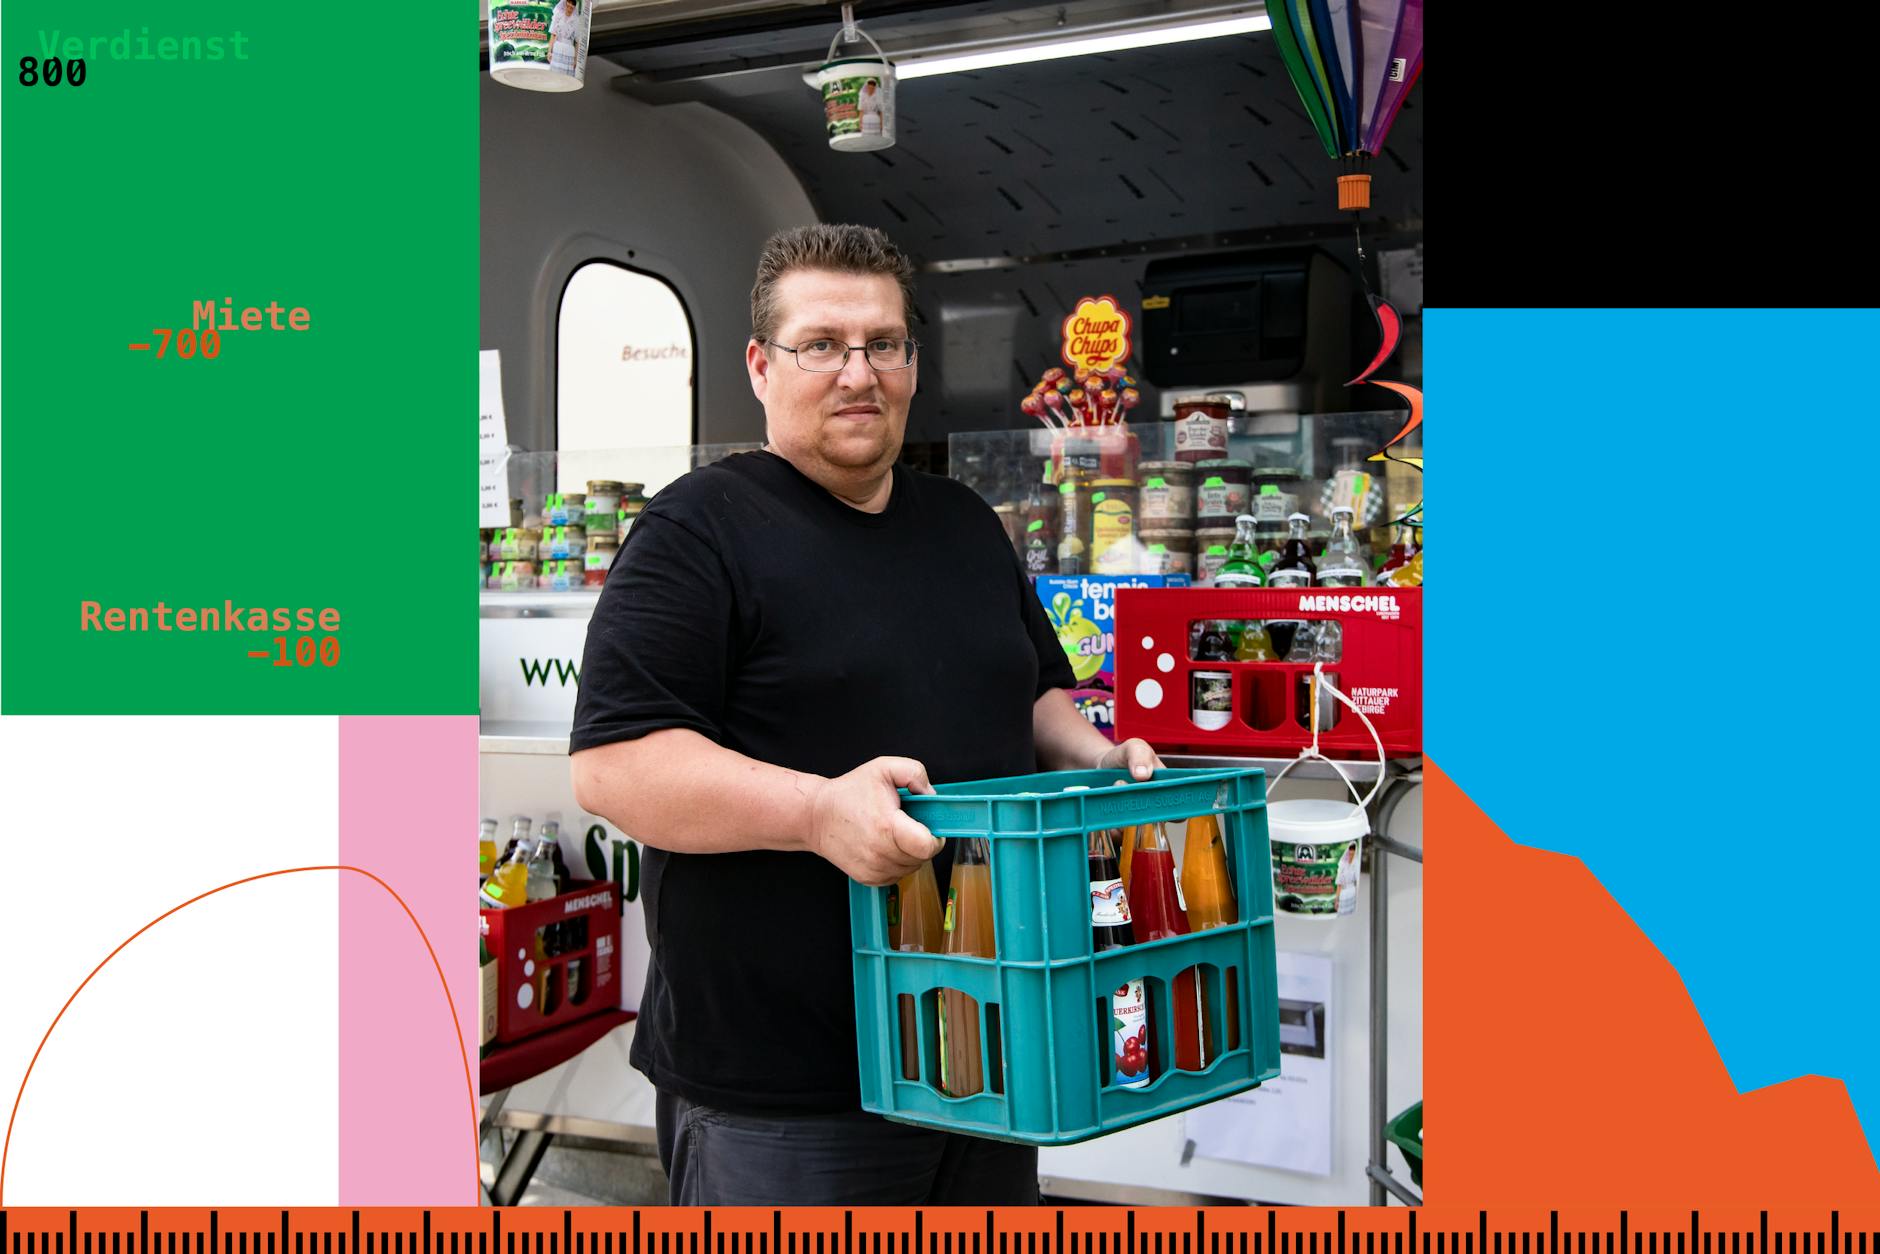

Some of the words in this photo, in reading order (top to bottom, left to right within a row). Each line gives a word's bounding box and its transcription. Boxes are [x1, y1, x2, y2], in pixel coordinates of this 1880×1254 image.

[1073, 317, 1120, 338] Chupa
[1070, 335, 1119, 360] Chups
[1298, 595, 1400, 612] MENSCHEL
[1351, 687, 1399, 698] NATURPARK
[1352, 696, 1390, 706] ZITTAUER
[585, 824, 640, 903] Sp
[564, 890, 613, 914] MENSCHEL
